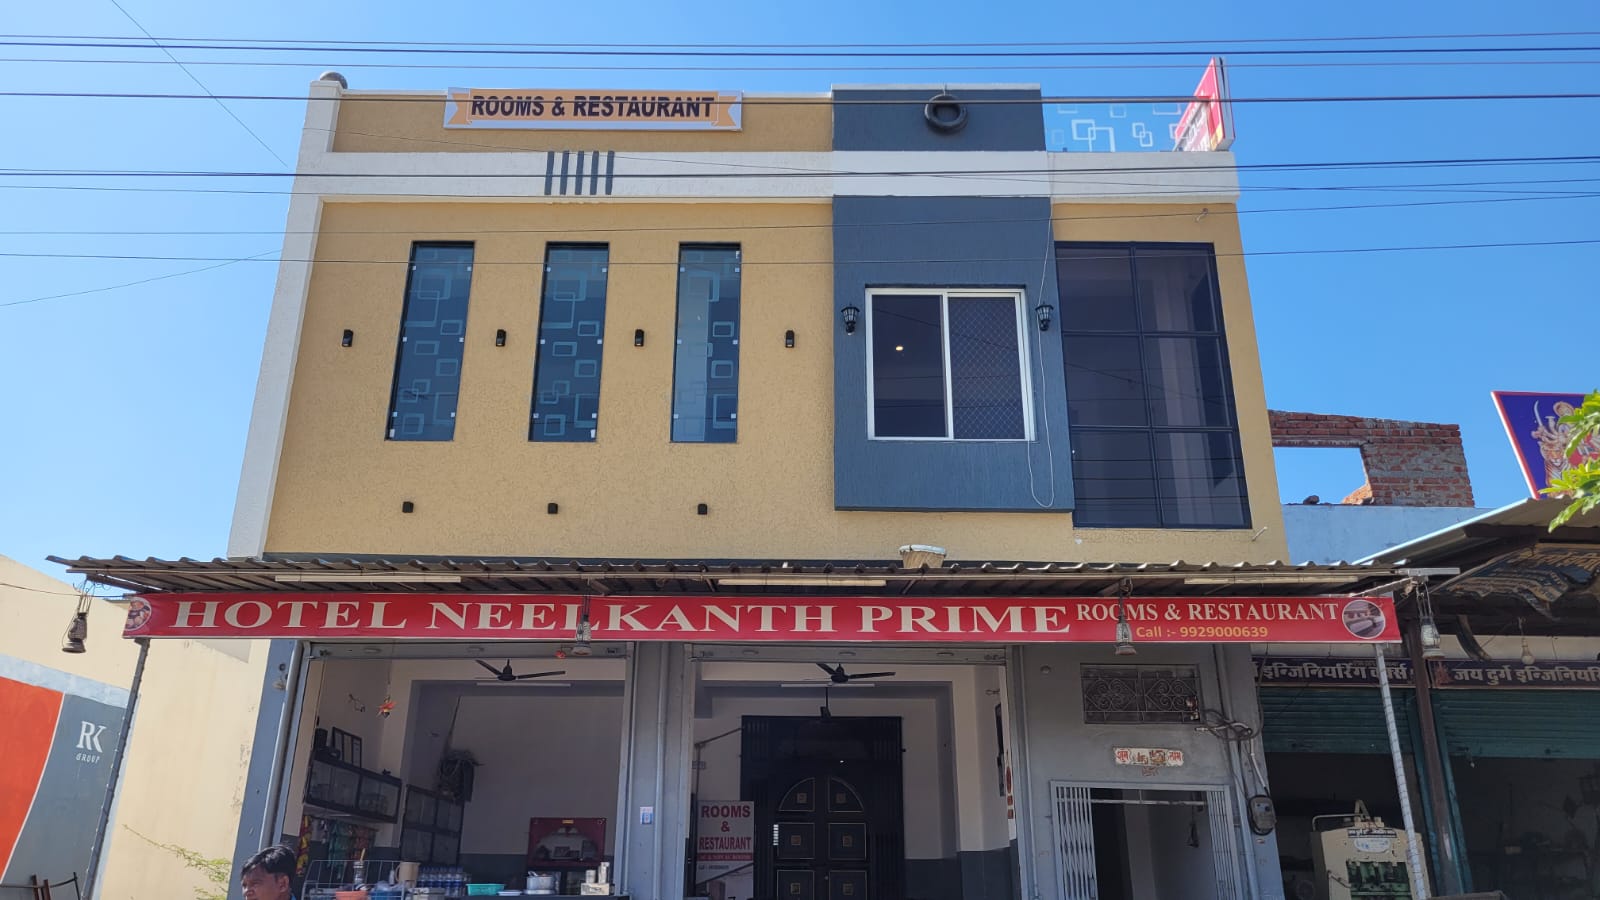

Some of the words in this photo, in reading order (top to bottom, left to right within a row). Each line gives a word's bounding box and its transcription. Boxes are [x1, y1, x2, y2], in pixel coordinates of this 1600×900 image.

[471, 95, 544, 117] ROOMS
[552, 96, 566, 117] &
[573, 95, 714, 118] RESTAURANT
[168, 600, 408, 630] HOTEL
[424, 602, 837, 633] NEELKANTH
[856, 604, 1072, 634] PRIME
[1076, 603, 1158, 621] ROOMS
[1164, 603, 1182, 621] &
[1187, 603, 1339, 621] RESTAURANT
[1136, 626, 1162, 638] Call
[1180, 626, 1269, 638] 9929000639
[1452, 667, 1484, 681] जय
[76, 720, 106, 753] RK
[701, 805, 751, 818] ROOMS
[721, 821, 730, 832] &
[700, 836, 752, 850] RESTAURANT
